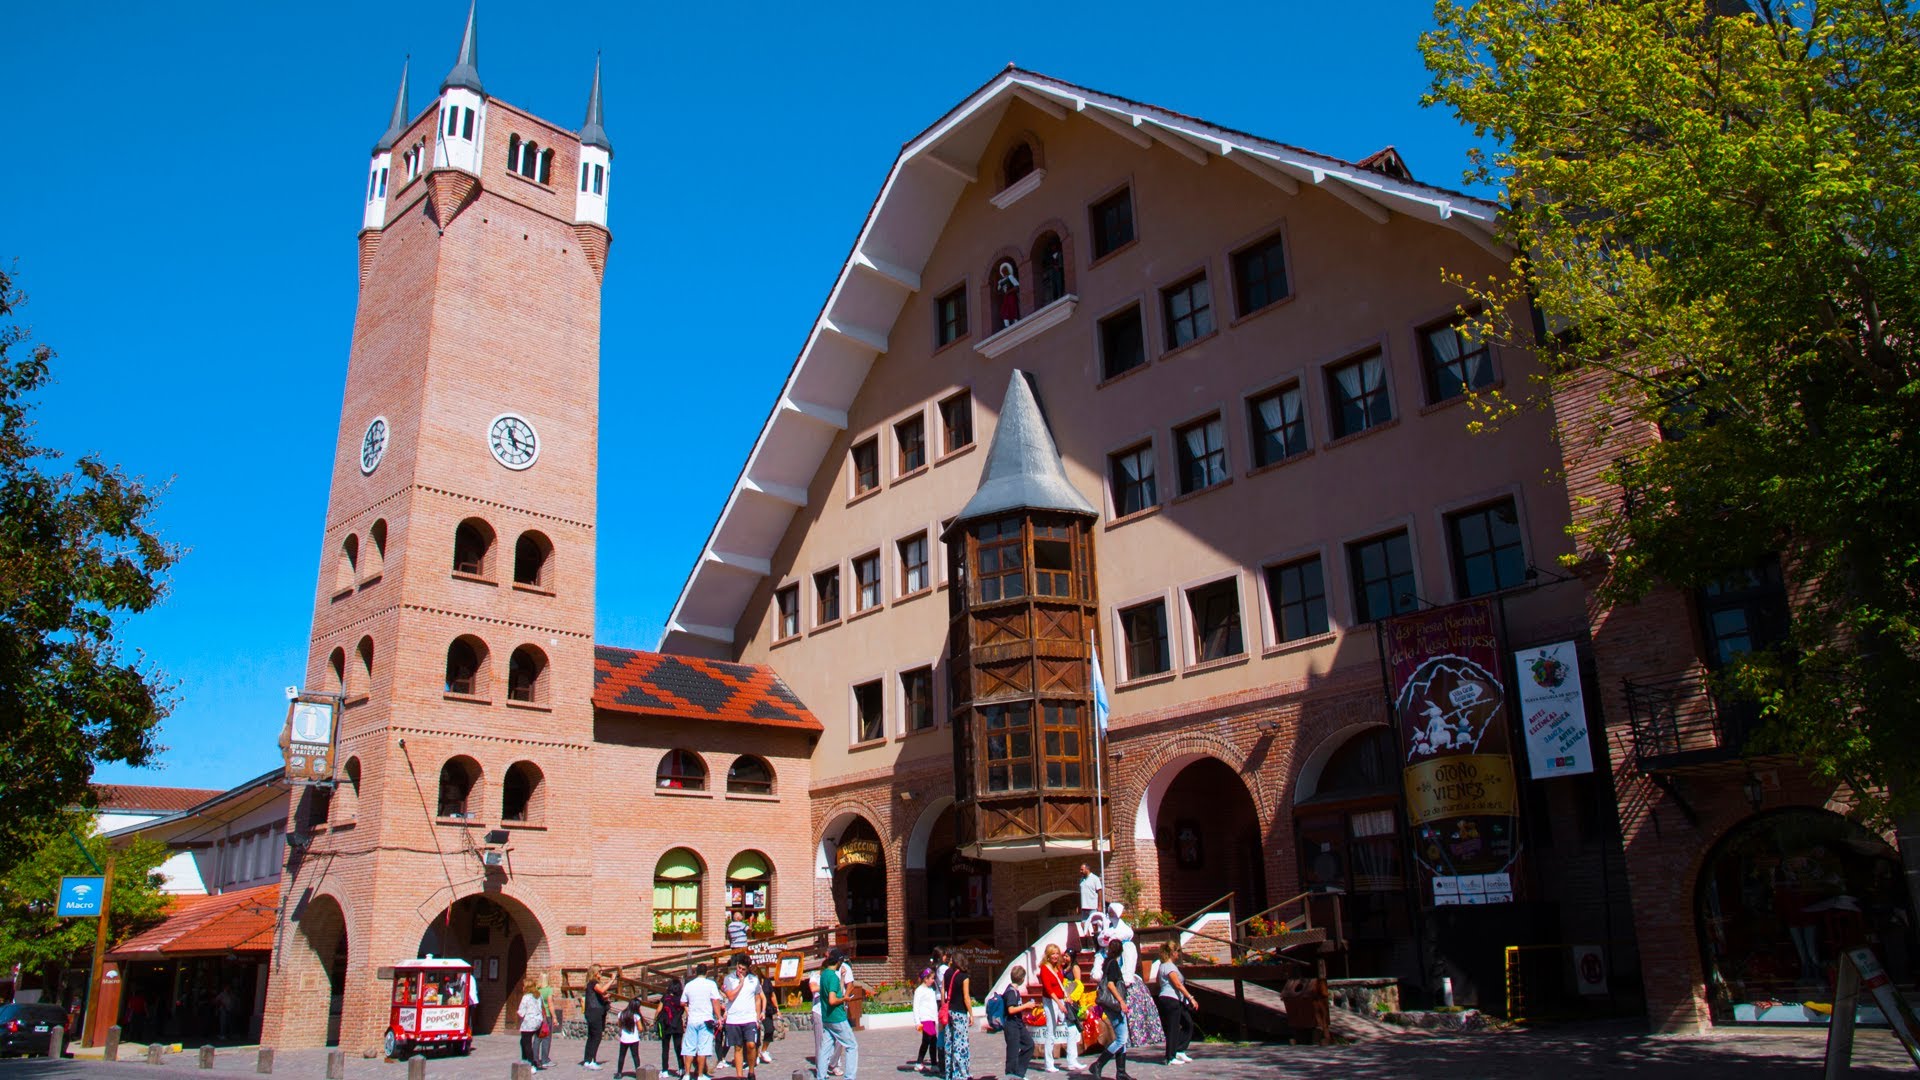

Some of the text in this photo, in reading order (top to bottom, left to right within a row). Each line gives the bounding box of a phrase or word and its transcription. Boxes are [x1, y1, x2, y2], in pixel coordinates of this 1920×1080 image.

[1444, 611, 1486, 632] Nacional
[1528, 708, 1546, 725] ARTES
[1544, 727, 1564, 744] DANZA
[1558, 726, 1576, 743] ARTES
[1435, 762, 1477, 782] OTOÑO
[66, 901, 94, 909] Macro
[425, 1011, 460, 1025] POPCORN
